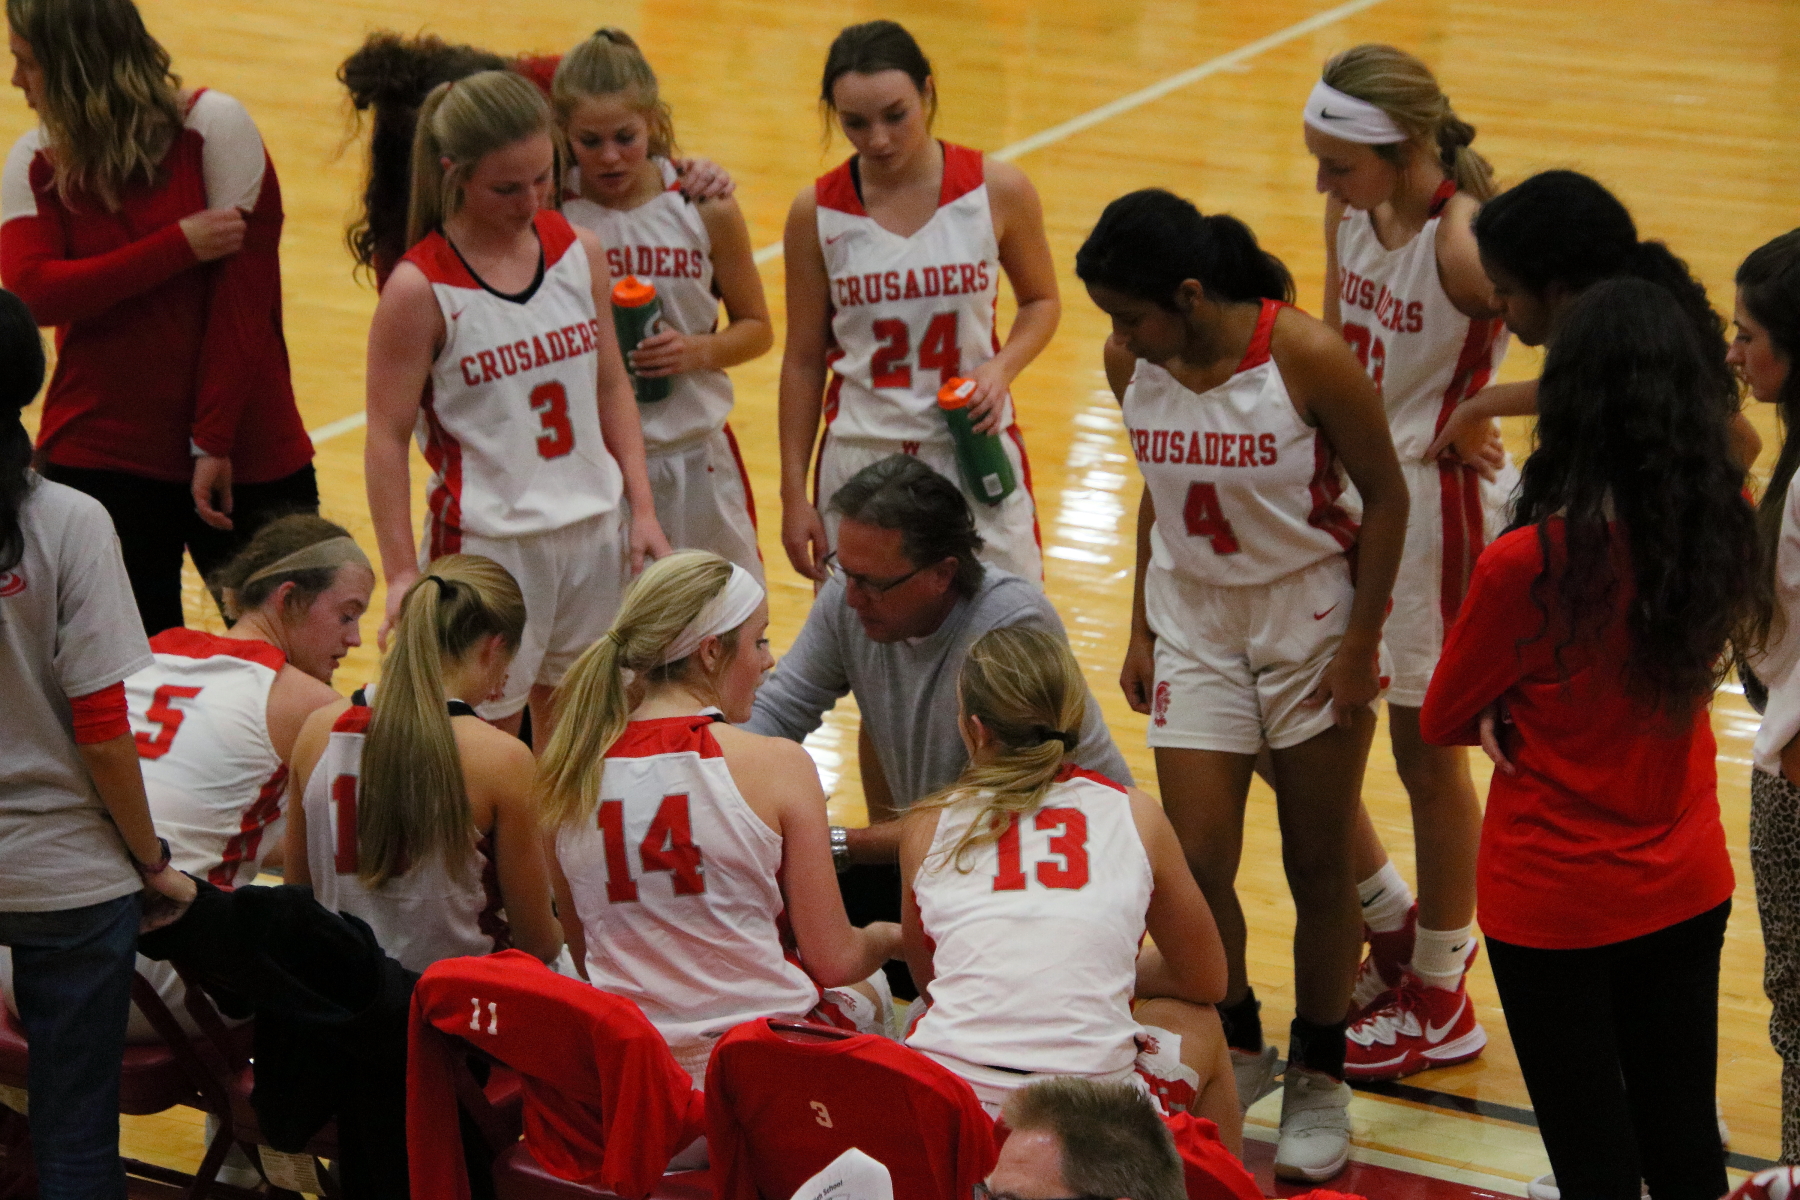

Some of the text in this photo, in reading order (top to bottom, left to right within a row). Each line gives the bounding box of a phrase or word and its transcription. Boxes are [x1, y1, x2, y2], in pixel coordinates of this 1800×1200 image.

[836, 260, 990, 306] CRUSADERS
[871, 310, 962, 389] 24
[528, 379, 575, 460] 3
[1182, 480, 1242, 556] 4
[134, 684, 206, 761] 5
[596, 791, 707, 904] 14
[989, 806, 1091, 893] 13
[469, 997, 498, 1036] 11
[809, 1100, 834, 1129] 3
